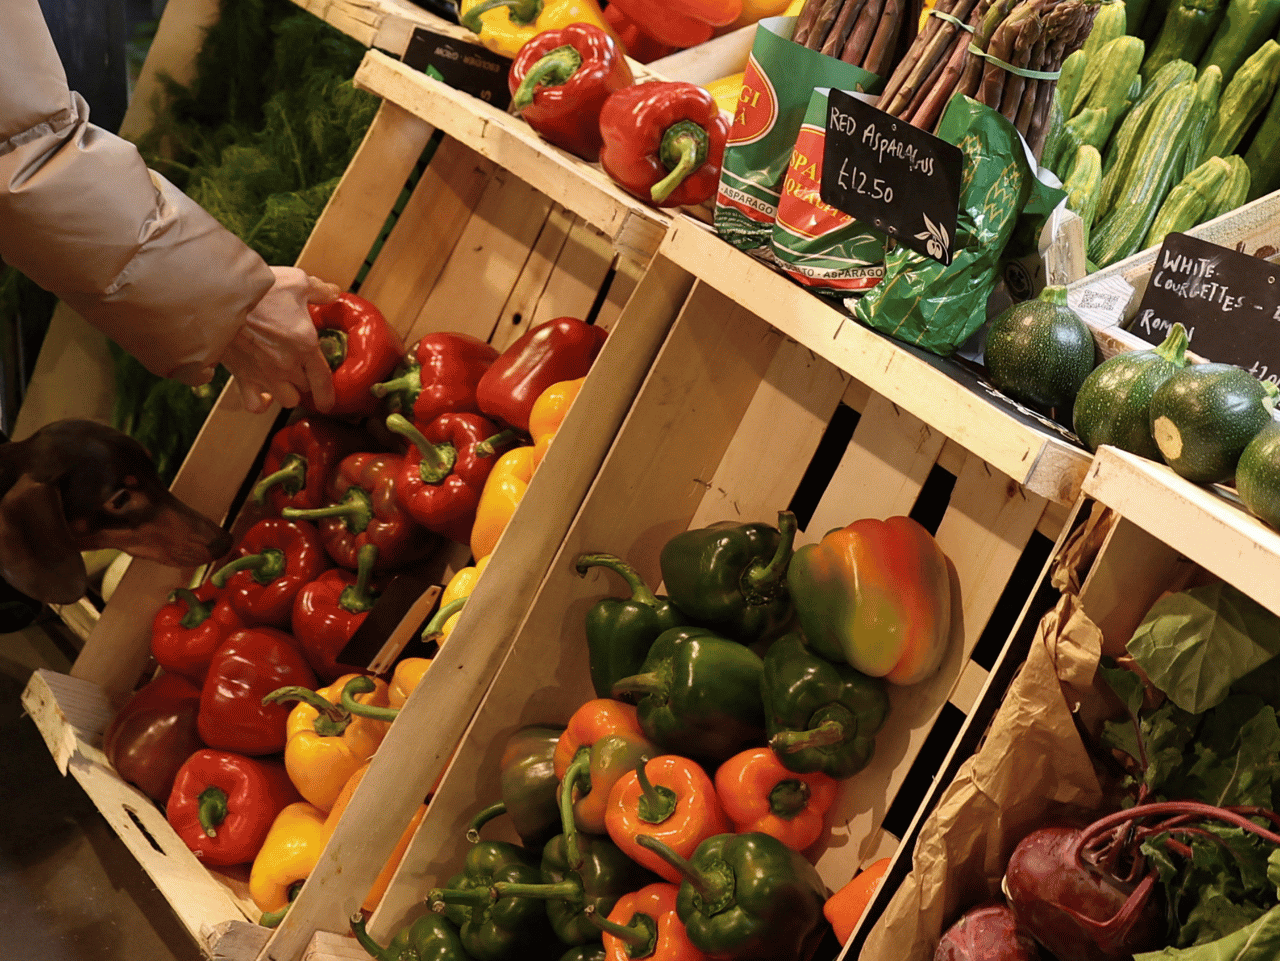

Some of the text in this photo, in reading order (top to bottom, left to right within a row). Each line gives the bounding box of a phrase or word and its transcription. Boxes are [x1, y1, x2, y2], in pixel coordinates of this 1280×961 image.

[829, 106, 857, 137] RED
[838, 156, 894, 203] £12.50
[724, 190, 774, 215] ASPARAGO
[823, 268, 884, 279] ASPARAGO
